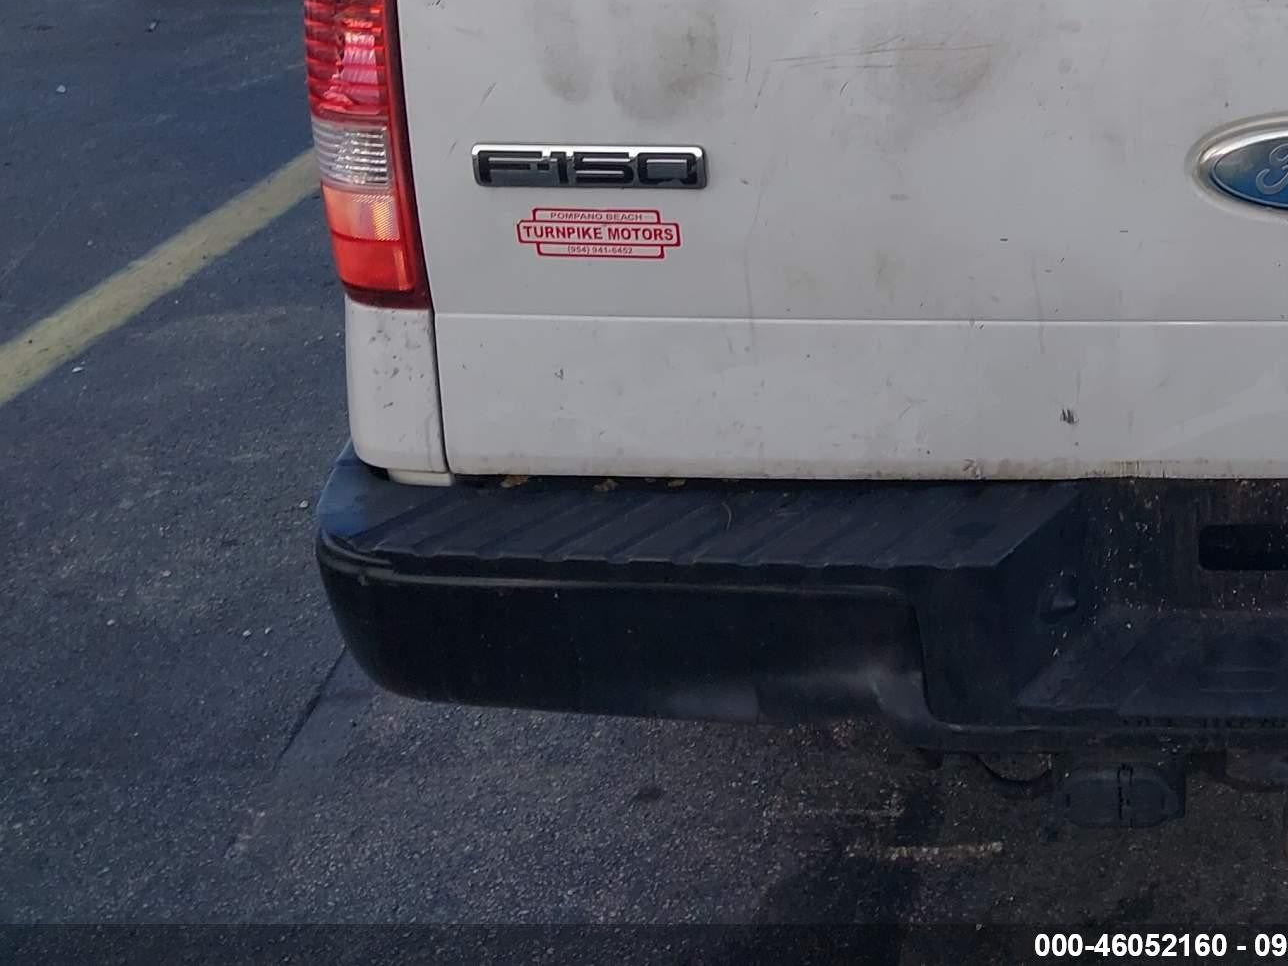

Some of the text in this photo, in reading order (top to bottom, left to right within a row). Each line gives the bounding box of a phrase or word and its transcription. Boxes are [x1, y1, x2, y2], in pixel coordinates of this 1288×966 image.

[550, 212, 643, 221] POMPANO BEACH
[523, 225, 674, 241] TURNPIKE MOTORS
